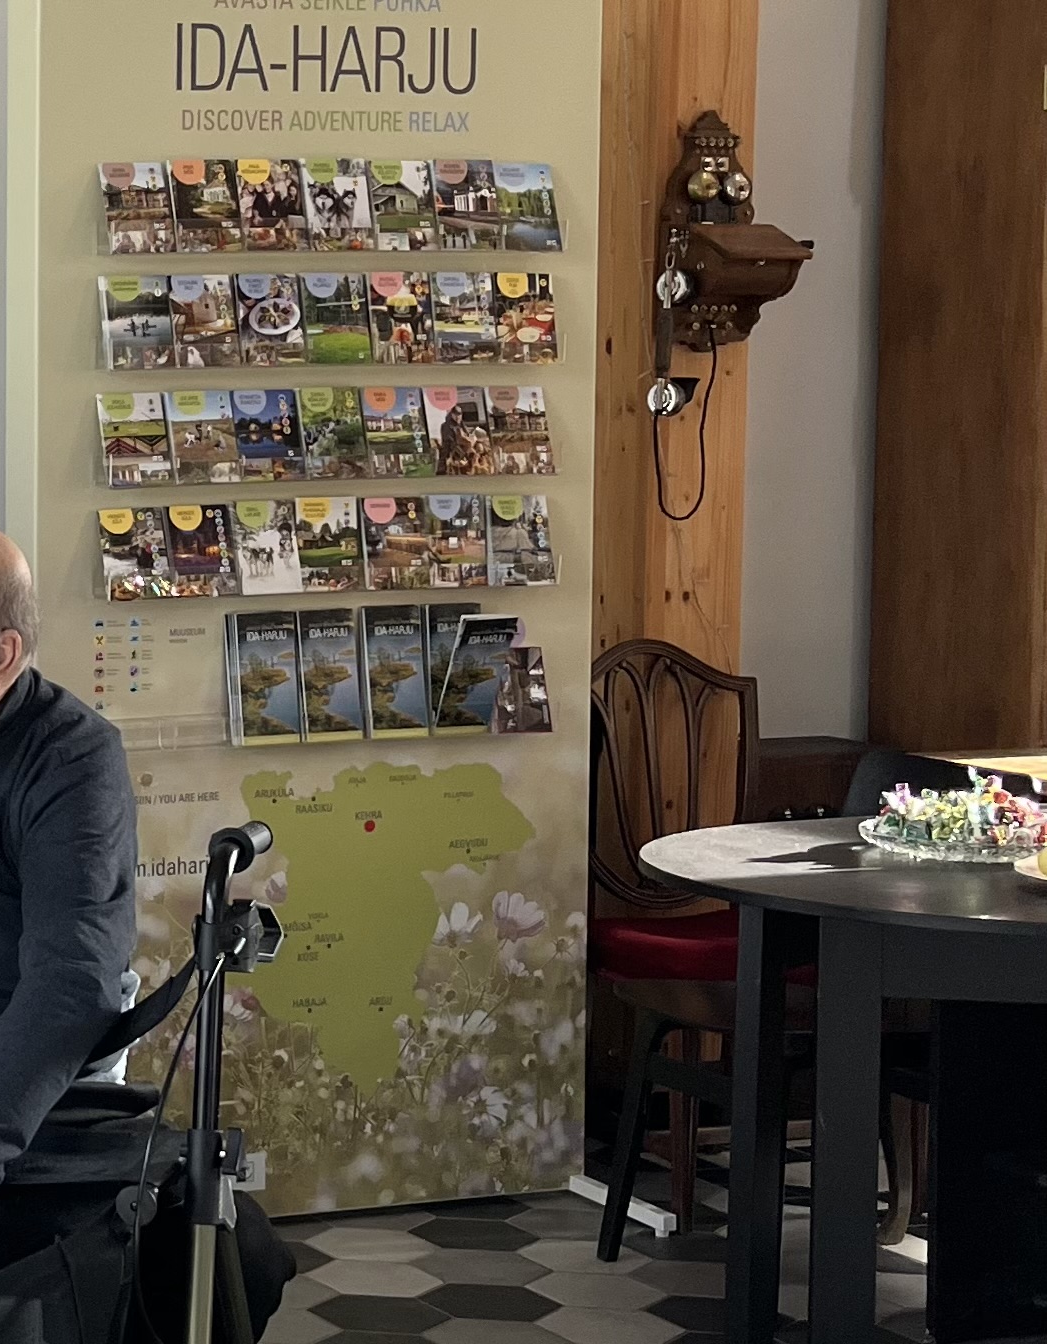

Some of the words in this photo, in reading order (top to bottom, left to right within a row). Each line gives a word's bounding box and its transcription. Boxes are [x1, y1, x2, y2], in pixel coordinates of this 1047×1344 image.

[175, 23, 477, 95] IDA-HARJU
[182, 109, 283, 131] DISCOVER
[289, 111, 403, 132] ADVENTURE
[409, 112, 470, 133] RELAX
[246, 630, 287, 642] IDA-HARJU
[309, 628, 348, 639] IDA-HARJU
[374, 625, 414, 636] IDA-HARJU
[467, 634, 507, 645] IDA-HARJU
[158, 794, 176, 804] YOU
[178, 792, 196, 802] ARE
[197, 791, 220, 802] HERE
[295, 803, 333, 814] RAASIKU
[355, 810, 383, 820] KEHRA
[292, 997, 327, 1008] HABAJA
